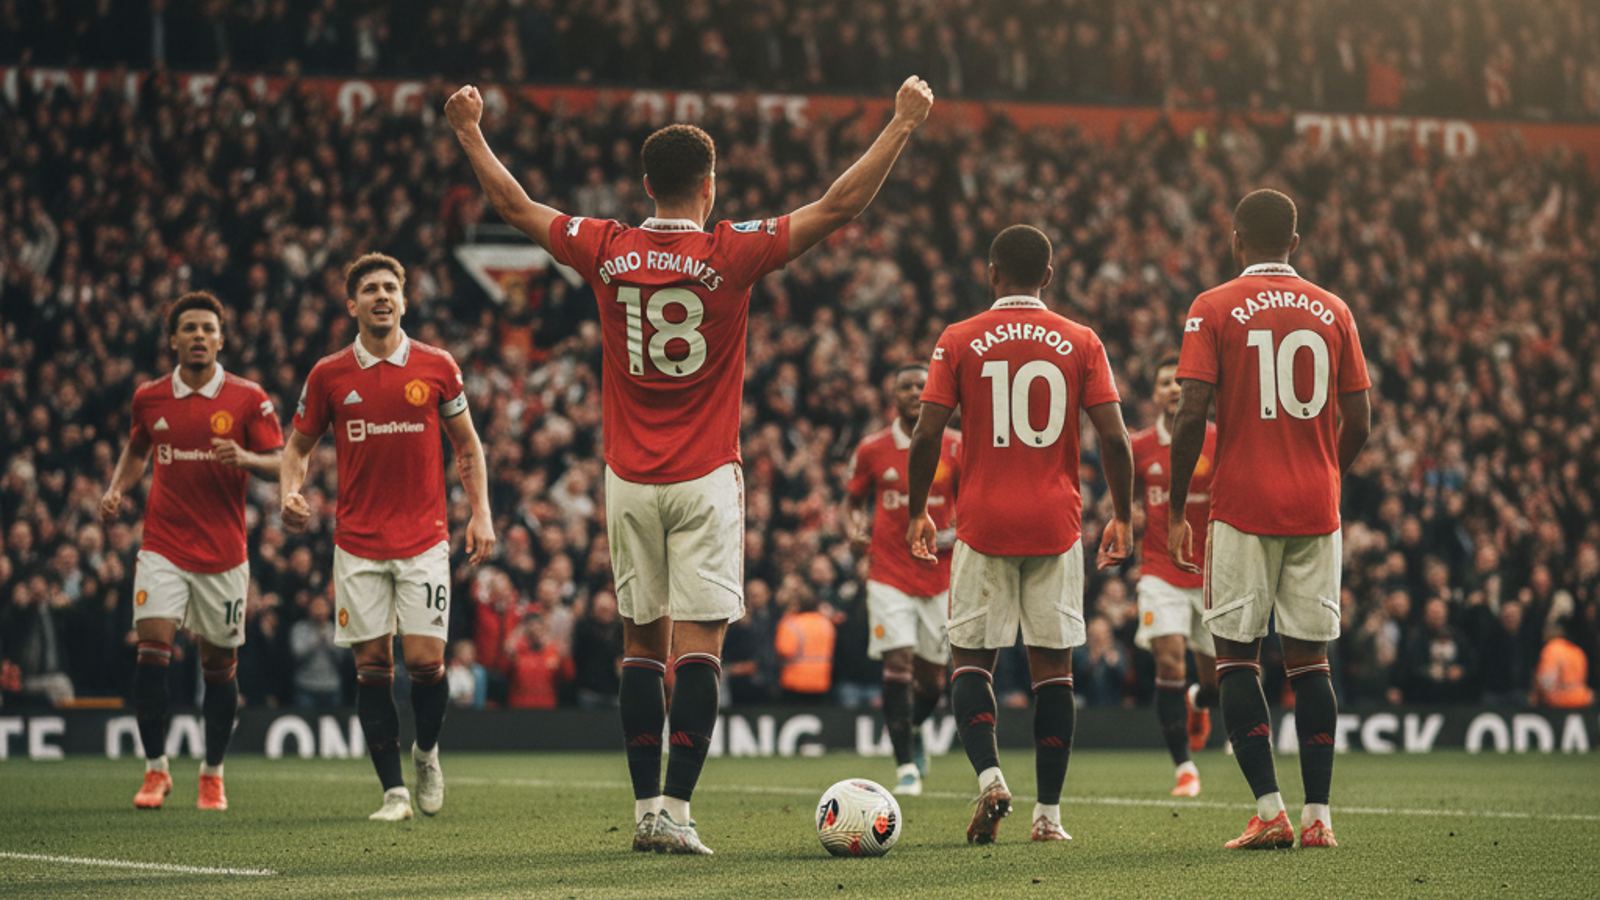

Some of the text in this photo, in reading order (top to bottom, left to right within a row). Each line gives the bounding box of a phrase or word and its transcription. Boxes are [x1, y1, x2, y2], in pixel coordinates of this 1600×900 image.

[616, 286, 708, 378] 18
[1231, 290, 1335, 326] RASHRAOD
[980, 360, 1067, 448] 10
[1247, 329, 1330, 420] 10
[423, 582, 447, 612] 16
